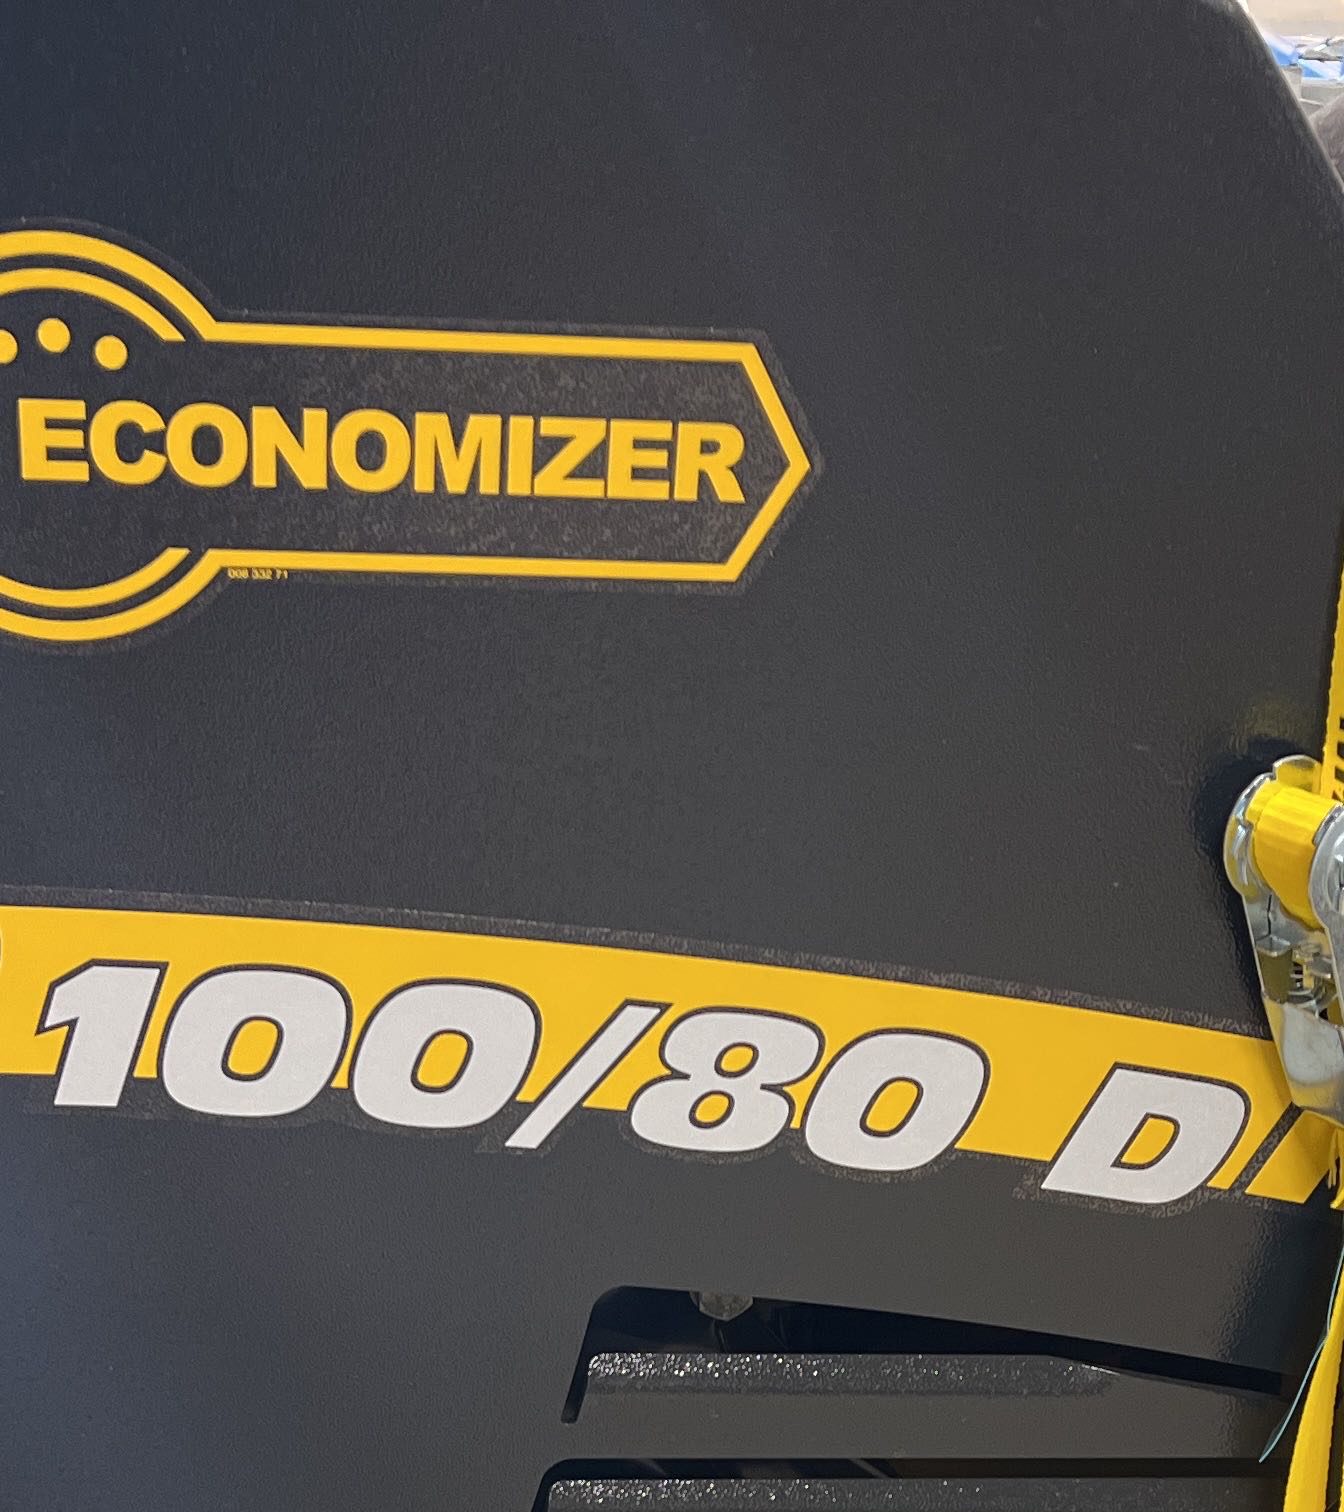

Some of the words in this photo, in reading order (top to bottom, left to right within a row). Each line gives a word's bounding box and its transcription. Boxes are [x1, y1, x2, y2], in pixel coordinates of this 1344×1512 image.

[17, 397, 745, 504] ECONOMIZER
[35, 959, 991, 1172] 100/80
[1041, 1061, 1252, 1204] D
